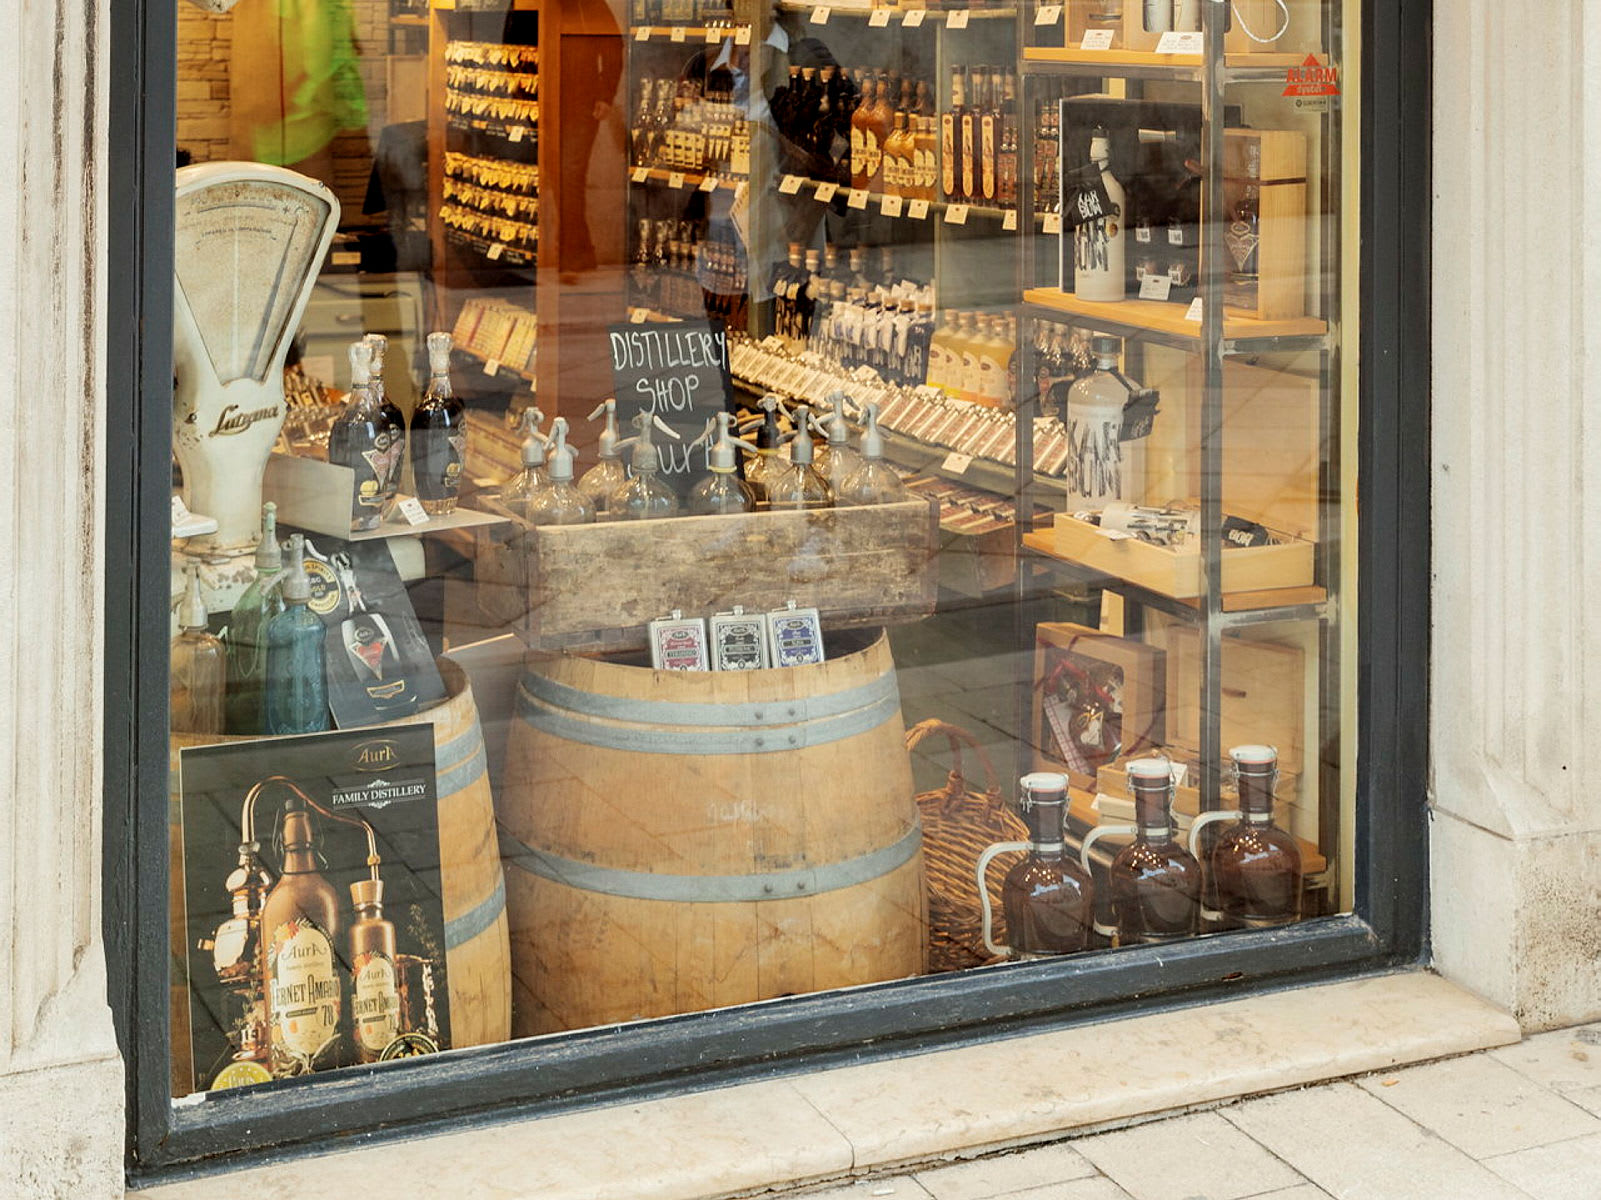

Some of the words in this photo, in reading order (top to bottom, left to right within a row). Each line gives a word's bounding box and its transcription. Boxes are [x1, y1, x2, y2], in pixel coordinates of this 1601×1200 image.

[1286, 67, 1337, 83] ALARM
[610, 331, 726, 371] DISTILLERY
[636, 374, 700, 415] SHOP
[332, 791, 370, 805] FAMILY
[370, 784, 427, 801] DISTILLERY
